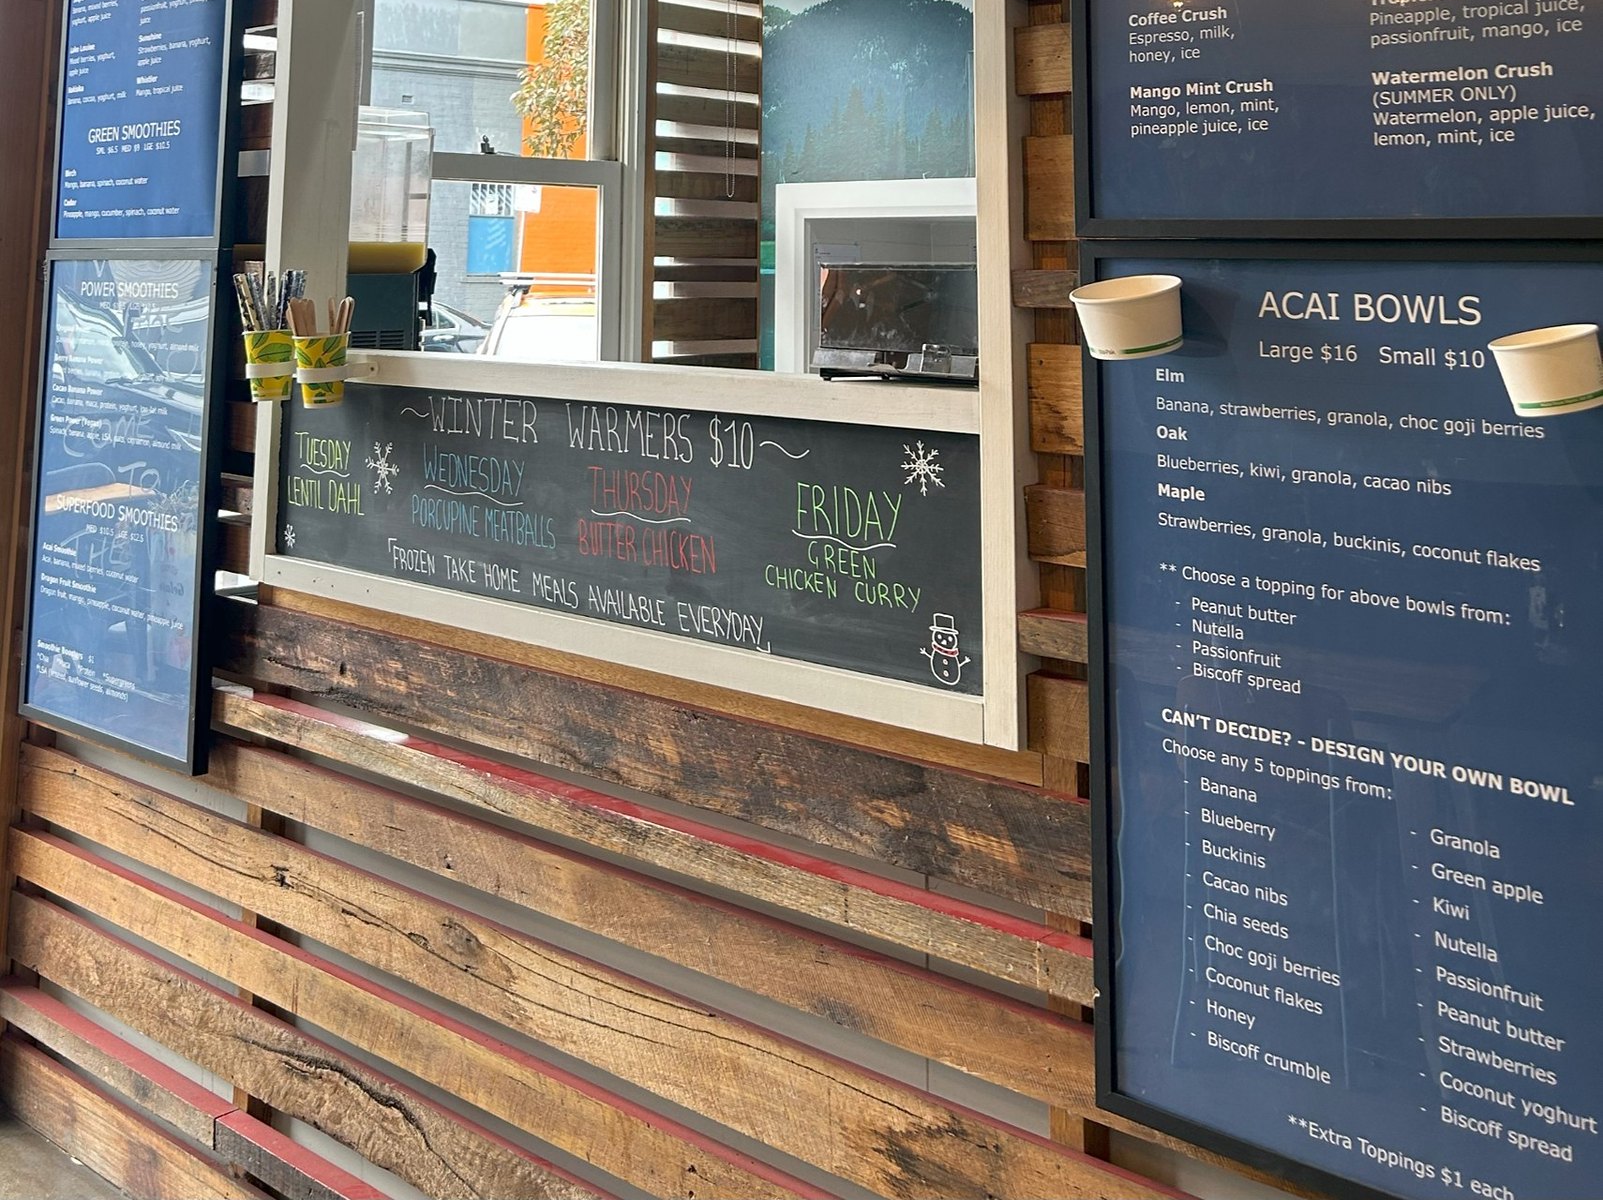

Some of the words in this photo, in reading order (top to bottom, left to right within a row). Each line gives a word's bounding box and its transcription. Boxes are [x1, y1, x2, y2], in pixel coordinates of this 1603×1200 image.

[1131, 87, 1180, 100] Mango
[1187, 83, 1221, 95] Mint
[1226, 79, 1273, 93] Crush
[1372, 67, 1488, 85] Watermelon
[1495, 62, 1552, 78] Crush
[1373, 109, 1482, 125] Watermelon,
[1490, 106, 1538, 123] apple
[1544, 106, 1594, 122] juice,
[1374, 89, 1454, 108] (SUMMER
[1461, 85, 1516, 102] ONLY)
[88, 126, 120, 144] GREEN
[121, 120, 181, 141] SMOOTHIES
[1131, 121, 1198, 137] pineapple
[1202, 120, 1241, 135] juice,
[1248, 118, 1268, 130] ice
[80, 281, 116, 297] POWER
[118, 282, 179, 299] SMOOTHIES
[1259, 292, 1339, 320] ACAI
[1355, 294, 1481, 325] BOWLS
[1260, 341, 1313, 362] Large
[1321, 344, 1357, 363] $16
[1380, 347, 1435, 365] Small
[1445, 349, 1484, 370] $10
[1156, 369, 1184, 382] Elm
[429, 396, 538, 444] WINTER
[565, 402, 694, 464] WARMERS
[709, 414, 754, 470] $10
[1157, 397, 1213, 416] Banana,
[1220, 403, 1320, 424] strawberries,
[1328, 412, 1392, 429] granola,
[1400, 414, 1438, 430] choc
[1444, 419, 1474, 436] goji
[1482, 420, 1544, 438] berries
[1157, 426, 1187, 440] Oak
[295, 431, 352, 470] TUESDAY
[423, 441, 525, 498] WEDNESDAY
[287, 475, 324, 512] LENTIL
[328, 479, 364, 516] DAHL
[587, 465, 693, 517] THURSDAY
[1158, 483, 1205, 501] Maple
[56, 494, 116, 519] SUPERFOOD
[118, 505, 179, 532] SMOOTHIES
[411, 494, 481, 538] PORCUPINE
[484, 507, 557, 550] MEATBALLS
[796, 481, 902, 542] FRIDAY
[577, 517, 636, 563] BUTTER
[642, 525, 717, 574] CHICKEN
[807, 540, 877, 580] GREEN
[72, 580, 97, 594] Smoothie
[393, 545, 436, 576] FROZEN
[444, 554, 477, 583] TAKE
[484, 563, 521, 593] HOME
[532, 572, 580, 610] MEALS
[588, 585, 666, 627] AVAILABLE
[677, 602, 764, 646] EVERYDAY
[765, 564, 838, 599] CHICKEN
[855, 580, 922, 613] CURRY
[1216, 719, 1291, 746] DECIDE?
[1312, 737, 1384, 765] DESIGN
[1390, 753, 1446, 778] YOUR
[1452, 766, 1502, 790] OWN
[1510, 778, 1574, 805] BOWL
[1357, 1137, 1435, 1178] Toppings
[1441, 1168, 1463, 1188] $1
[1471, 1180, 1514, 1200] each
